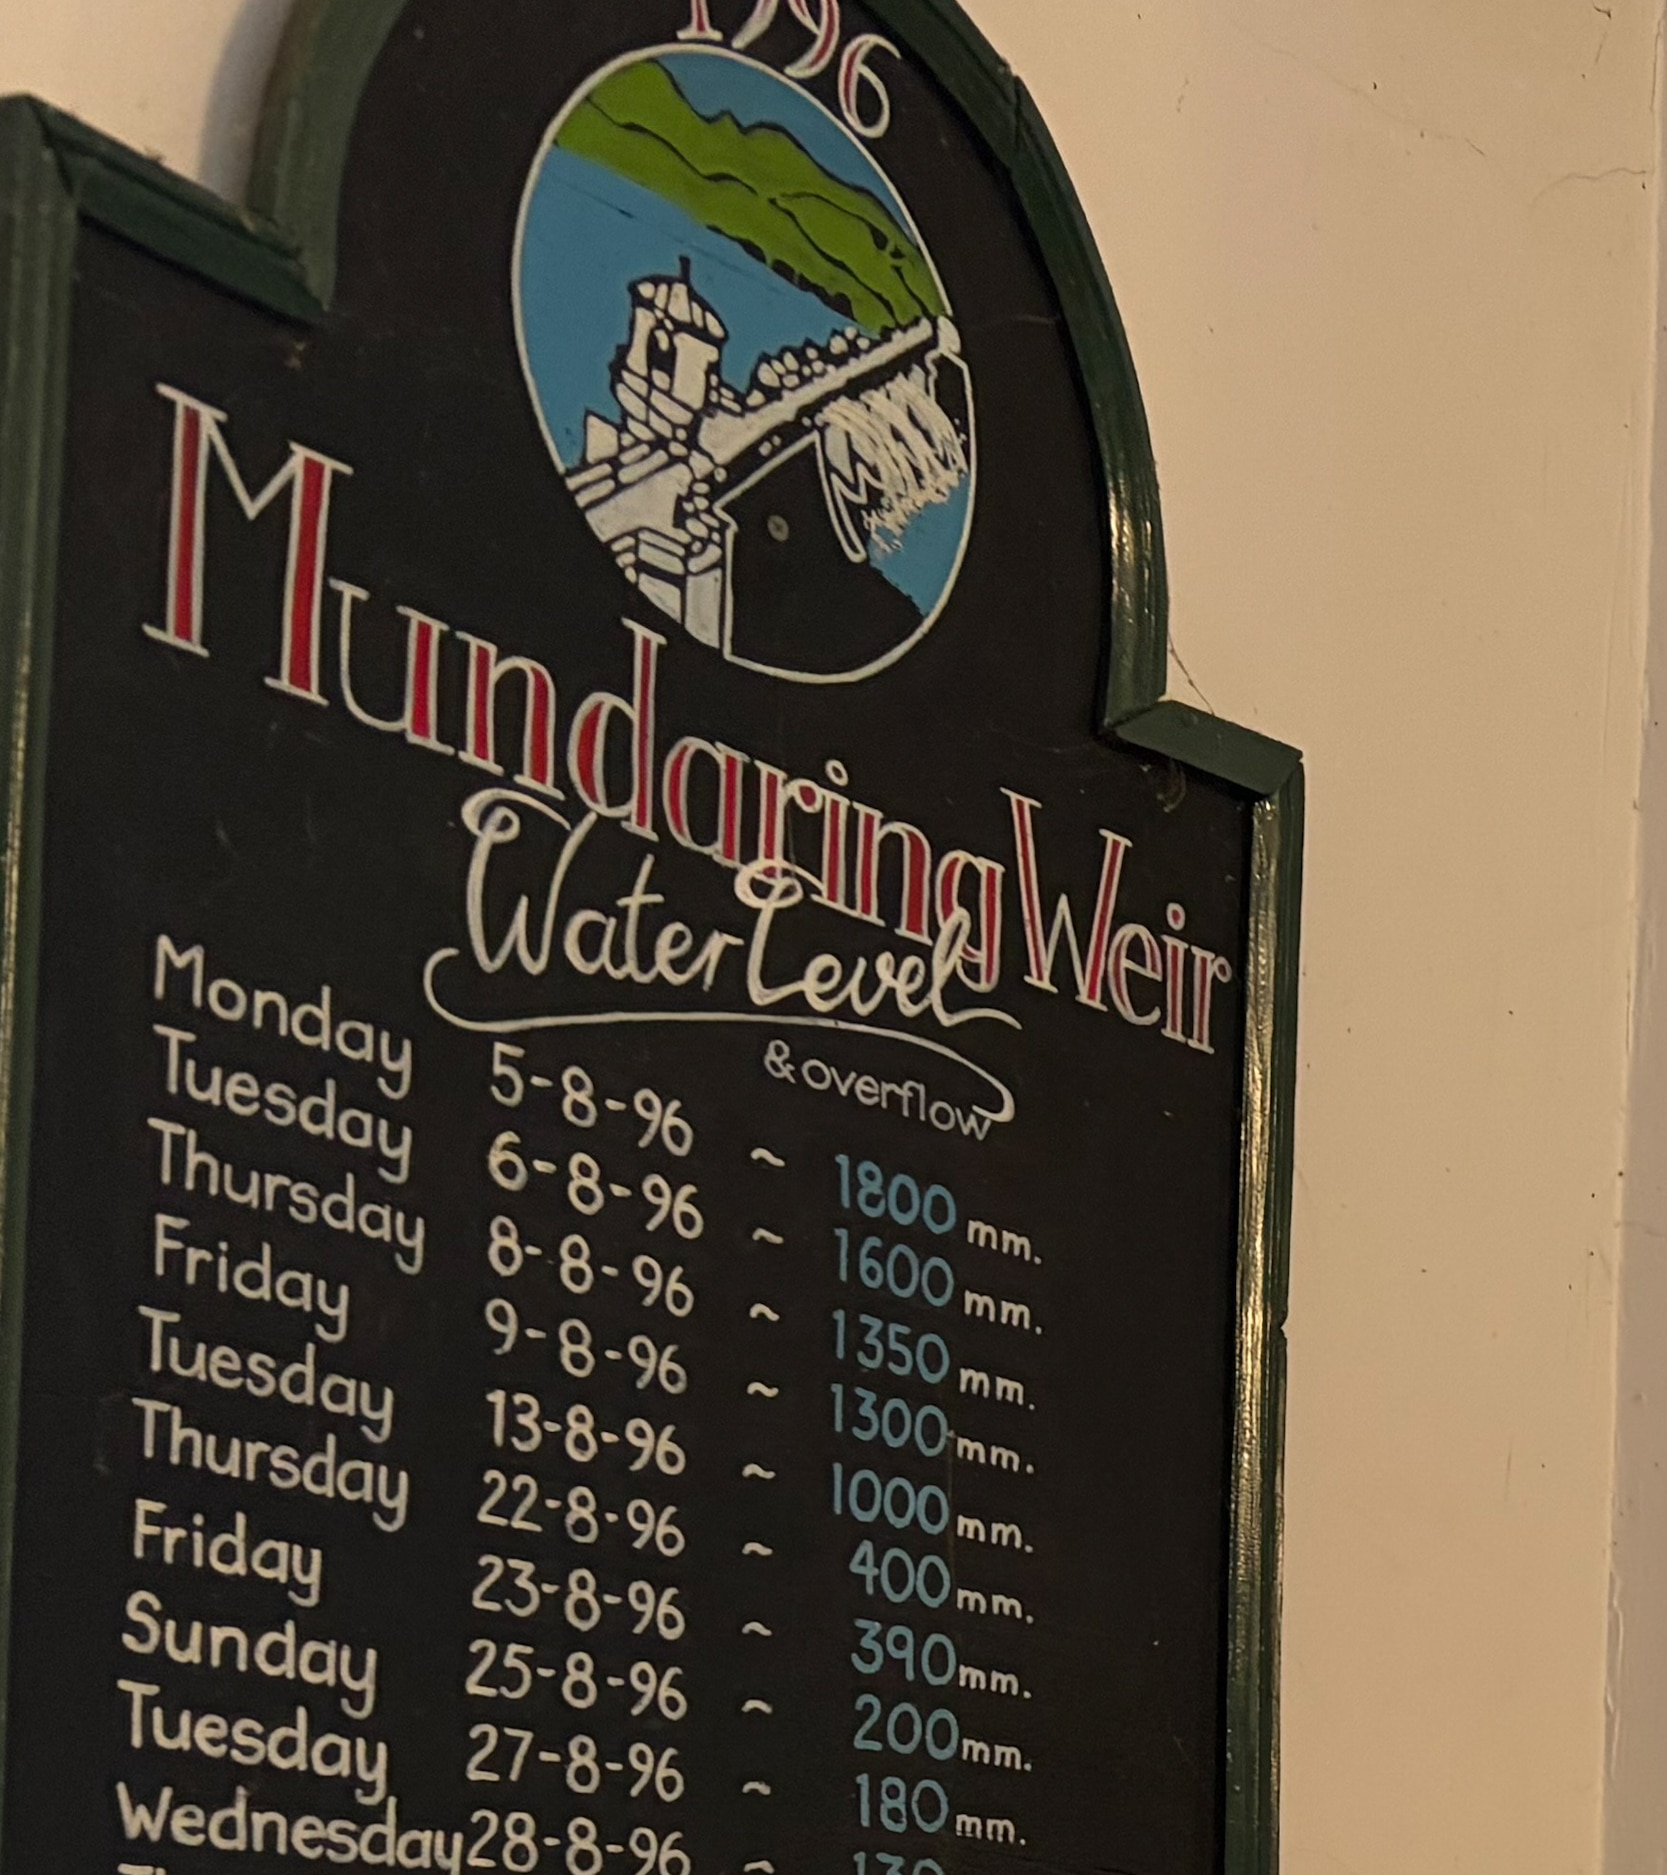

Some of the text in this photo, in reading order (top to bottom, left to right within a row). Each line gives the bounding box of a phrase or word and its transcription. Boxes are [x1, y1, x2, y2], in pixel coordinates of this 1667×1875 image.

[142, 383, 1232, 1053] Mundaring Weir
[460, 788, 1022, 1029] Water Level
[153, 1024, 412, 1184] Tuesday
[487, 1131, 703, 1239] 6-8-96
[834, 1228, 954, 1306] 1600
[154, 934, 412, 1099] Monday
[491, 1042, 693, 1156] 5-8-96
[835, 1154, 957, 1234] 1800
[147, 1117, 425, 1275] Thursday
[488, 1215, 694, 1317] 8-8-96
[833, 1309, 950, 1384] 1350
[155, 1213, 350, 1343] Friday
[485, 1298, 687, 1394] 9-8-96
[831, 1383, 948, 1457] 1300
[131, 1397, 408, 1532] Thursday
[477, 1469, 685, 1557] 22-8-96
[849, 1539, 951, 1608] 400
[137, 1305, 393, 1443] Tuesday
[486, 1389, 686, 1475] 13-8-96
[833, 1462, 949, 1535] 1000
[121, 1590, 378, 1720] Sunday
[465, 1639, 687, 1721] 25-8-96
[854, 1694, 959, 1760] 200
[134, 1499, 323, 1608] Friday
[471, 1554, 685, 1641] 23-8-96
[851, 1618, 957, 1686] 390
[117, 1679, 388, 1806] Tuesday
[465, 1724, 685, 1801] 27-8-96
[856, 1773, 949, 1833] 180
